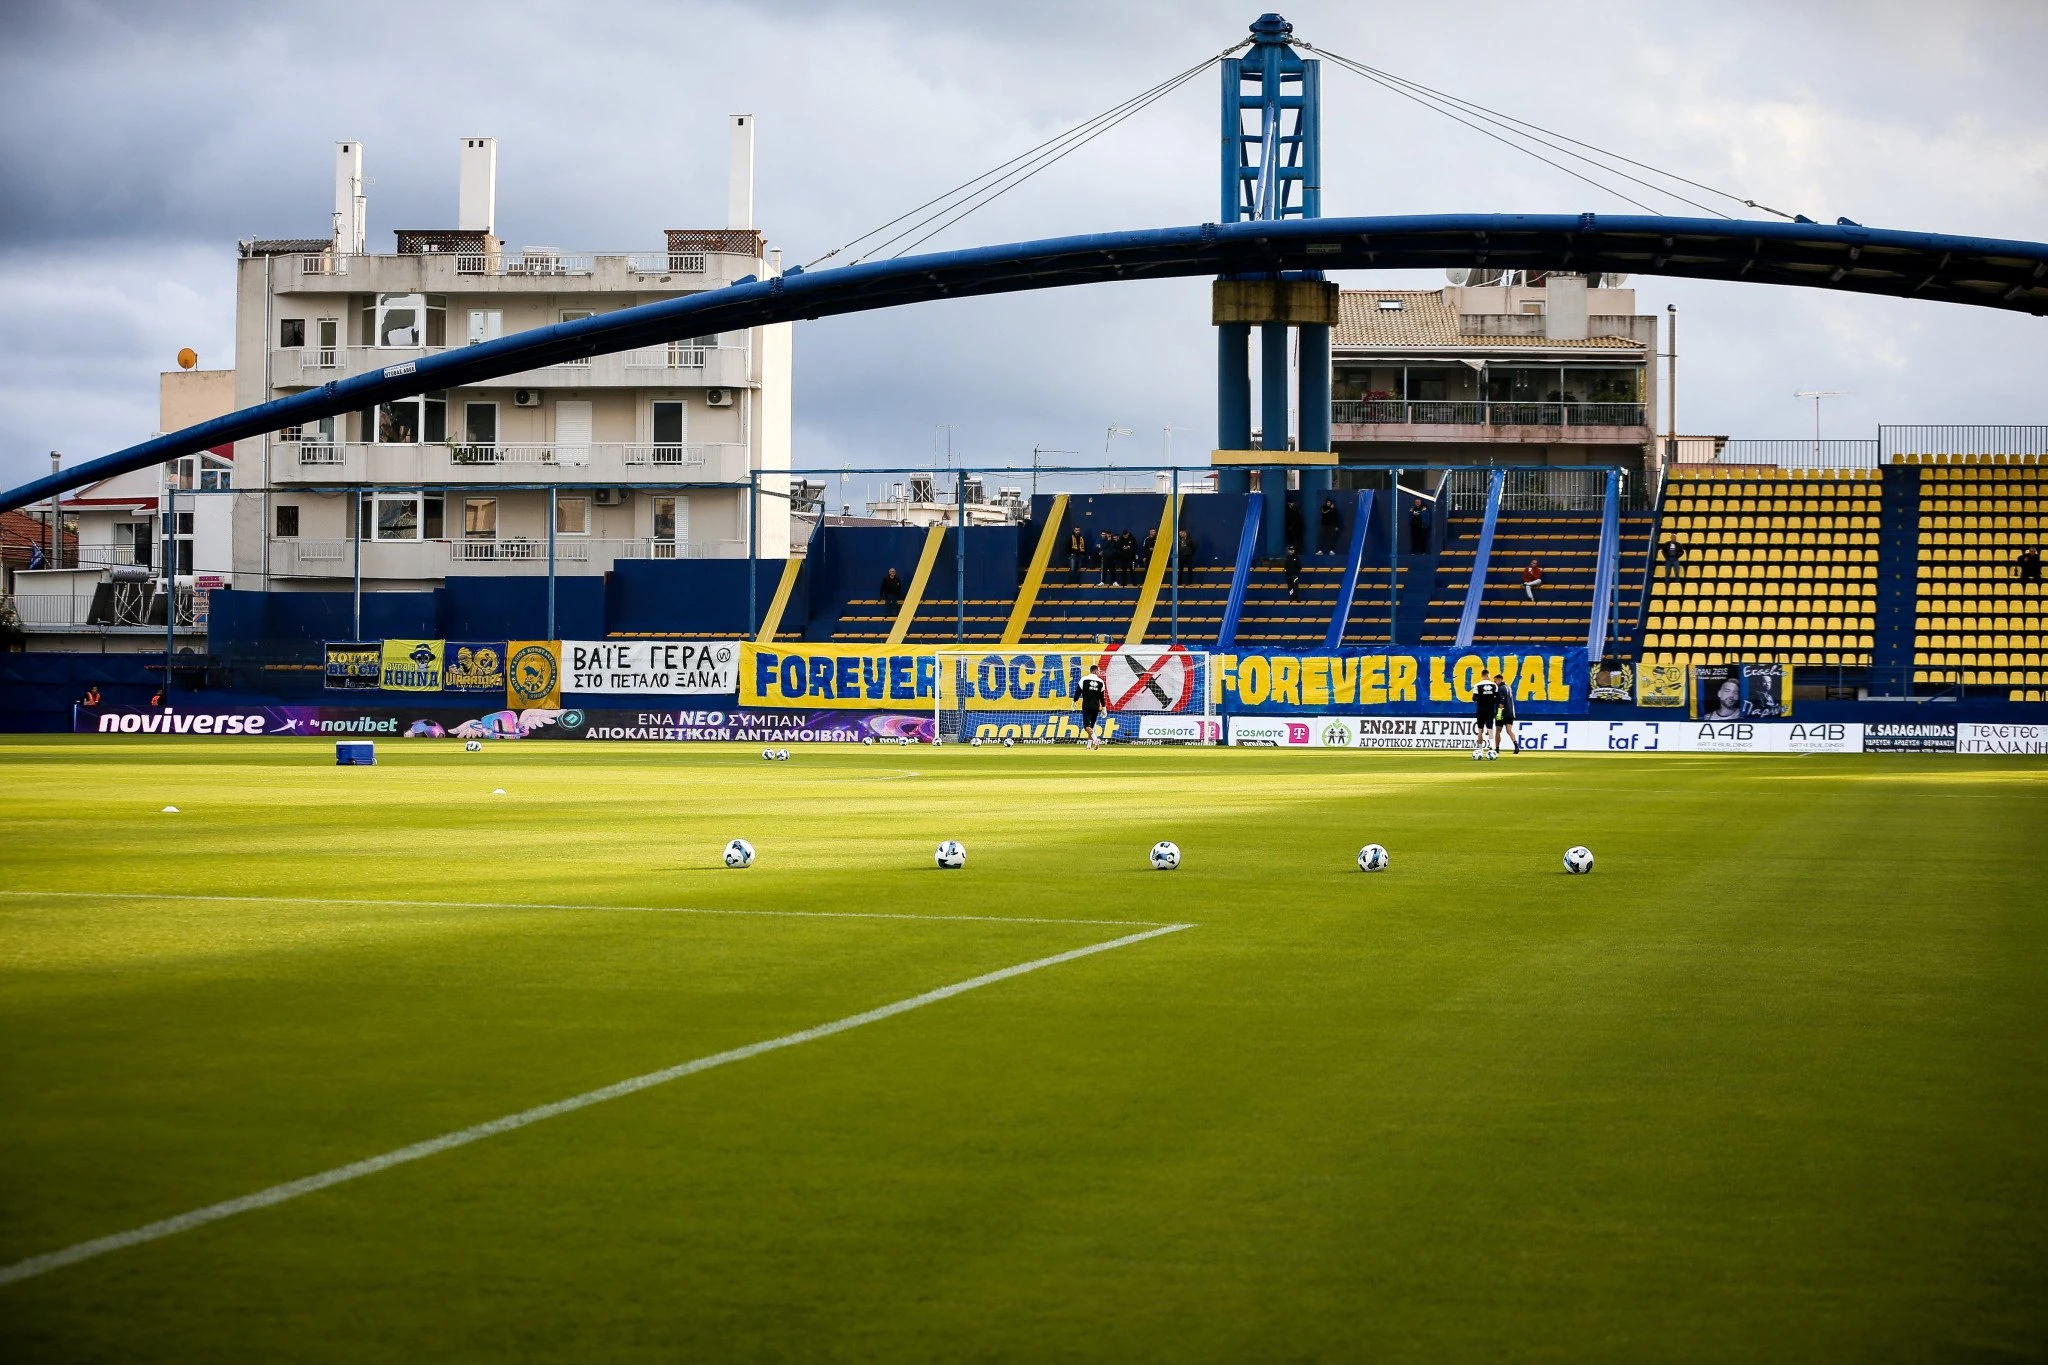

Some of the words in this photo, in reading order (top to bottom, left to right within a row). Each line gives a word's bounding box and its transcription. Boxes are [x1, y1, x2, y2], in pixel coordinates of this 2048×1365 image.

[327, 652, 379, 663] YOUTH
[650, 645, 715, 670] ΓΕΡΑ
[384, 671, 439, 686] ΑΘΗΝΑ
[574, 674, 602, 688] ΣΤΟ
[611, 673, 669, 688] ΠΕΤΑΛΟ
[675, 672, 727, 688] ΞΑΝΑ!
[756, 652, 942, 699] FOREVER
[1211, 655, 1417, 705] FOREVER
[1431, 655, 1570, 702] LOYAL
[98, 707, 265, 734] noviverse
[321, 717, 397, 732] novibet
[638, 714, 674, 726] ΕΝΑ
[679, 711, 723, 726] ΝΕΟ
[729, 714, 806, 727] ΣΥΜΠΑΝ
[975, 716, 1120, 738] novibet
[1359, 720, 1416, 734] ΕΝΩΣΗ
[585, 728, 730, 741] ΑΠΟΚΛΕΙΣΤΙΚΩΝ
[735, 729, 859, 742] ΑΝΤΑΜΟΙΒΩΝ
[1236, 729, 1284, 738] COSMOTE
[1698, 723, 1754, 740] A4B
[1790, 724, 1845, 741] A4B
[1865, 725, 1875, 736] K.
[1877, 725, 1955, 737] SARAGANIDAS
[1359, 739, 1413, 747] ΑΓΡΟΤΙΚΟΣ
[1517, 733, 1548, 749] taf
[1609, 733, 1639, 750] taf
